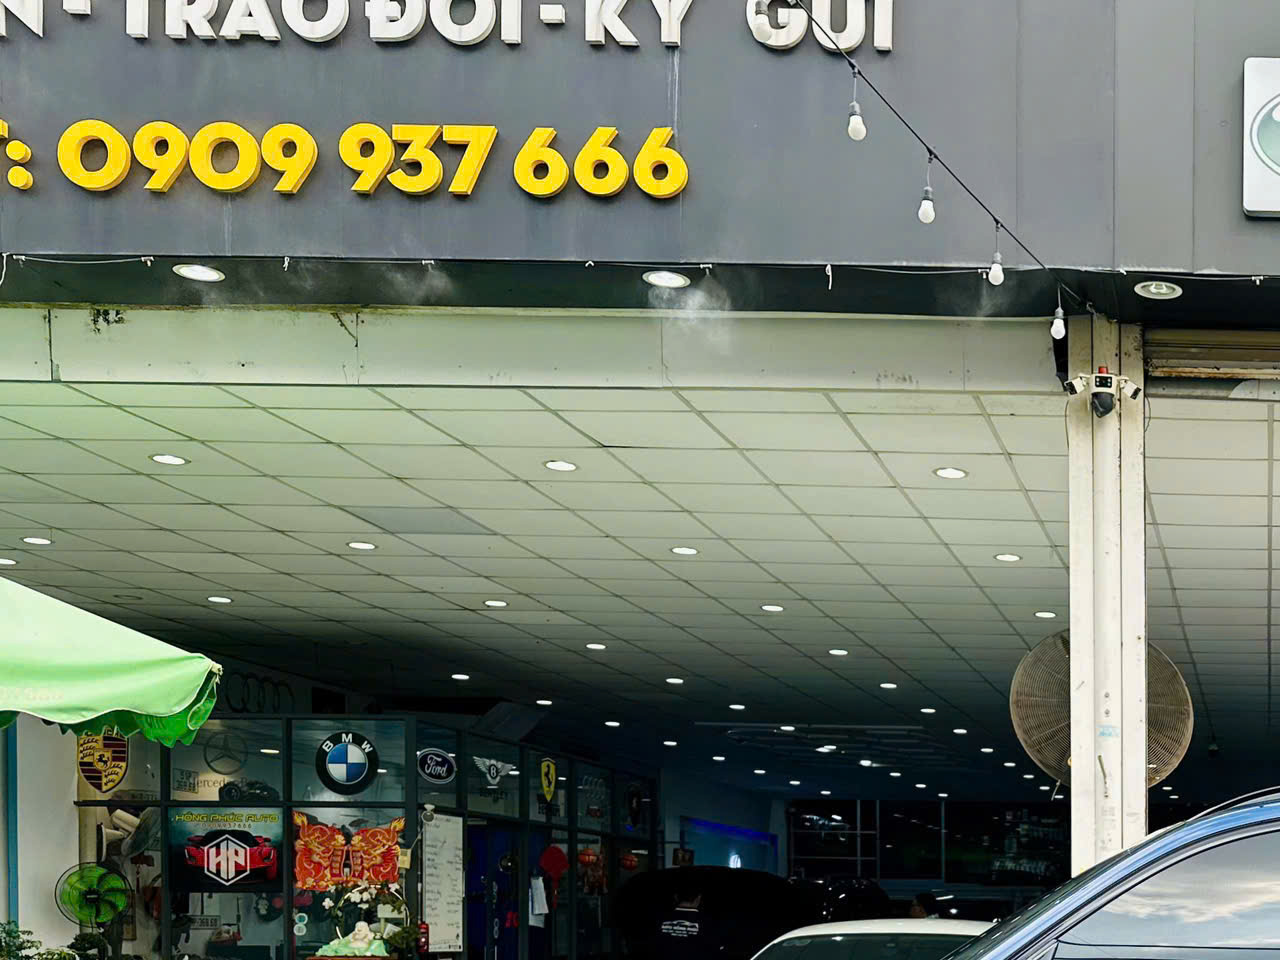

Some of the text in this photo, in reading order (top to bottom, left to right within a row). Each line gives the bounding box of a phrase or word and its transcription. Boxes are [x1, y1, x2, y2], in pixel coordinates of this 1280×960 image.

[56, 118, 320, 195] 0909
[337, 121, 499, 196] 937
[513, 126, 689, 199] 666
[322, 733, 374, 753] BMW
[424, 753, 448, 778] Ford
[208, 840, 246, 880] HP
